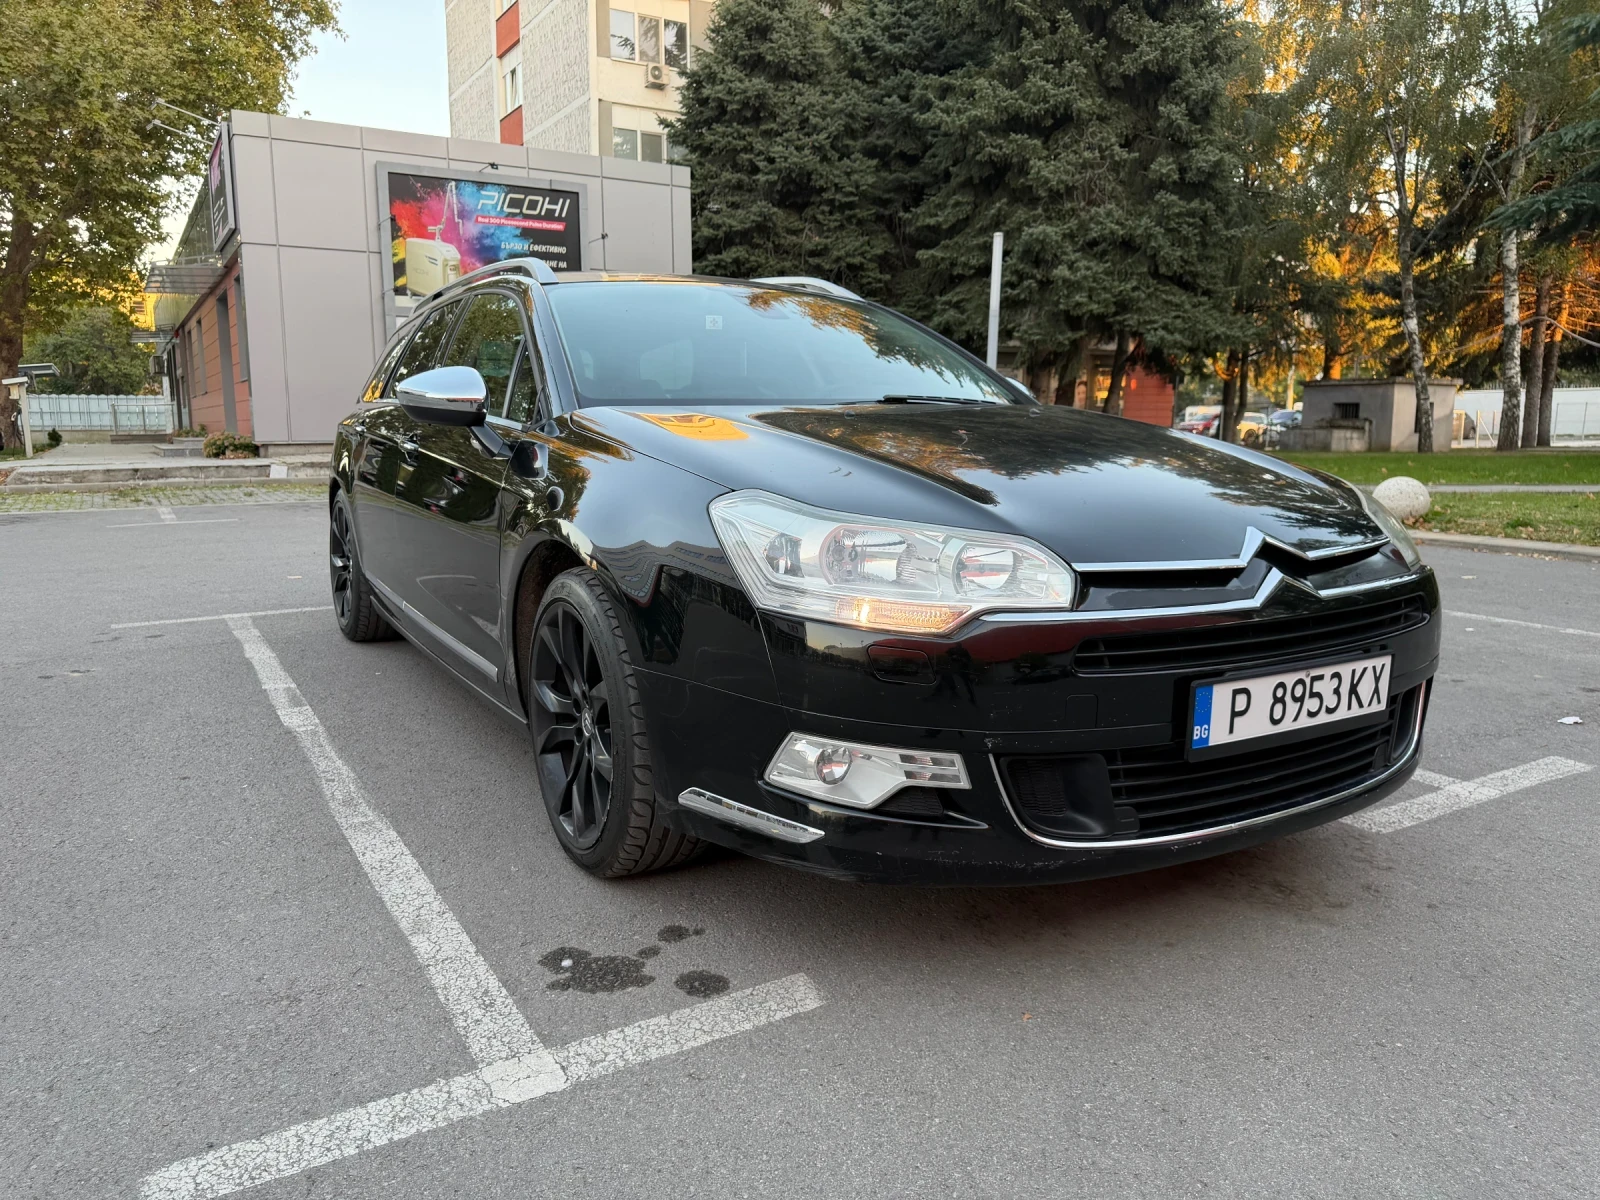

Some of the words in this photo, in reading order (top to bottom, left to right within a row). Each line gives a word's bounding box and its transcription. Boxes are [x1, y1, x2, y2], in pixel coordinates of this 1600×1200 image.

[478, 190, 570, 218] PICOHI
[543, 222, 563, 230] Duration
[501, 242, 522, 251] БЪРЗО
[530, 244, 567, 254] ЕФЕКТИВНО
[558, 260, 567, 269] НА
[1228, 687, 1252, 735] P
[1193, 725, 1209, 740] BG
